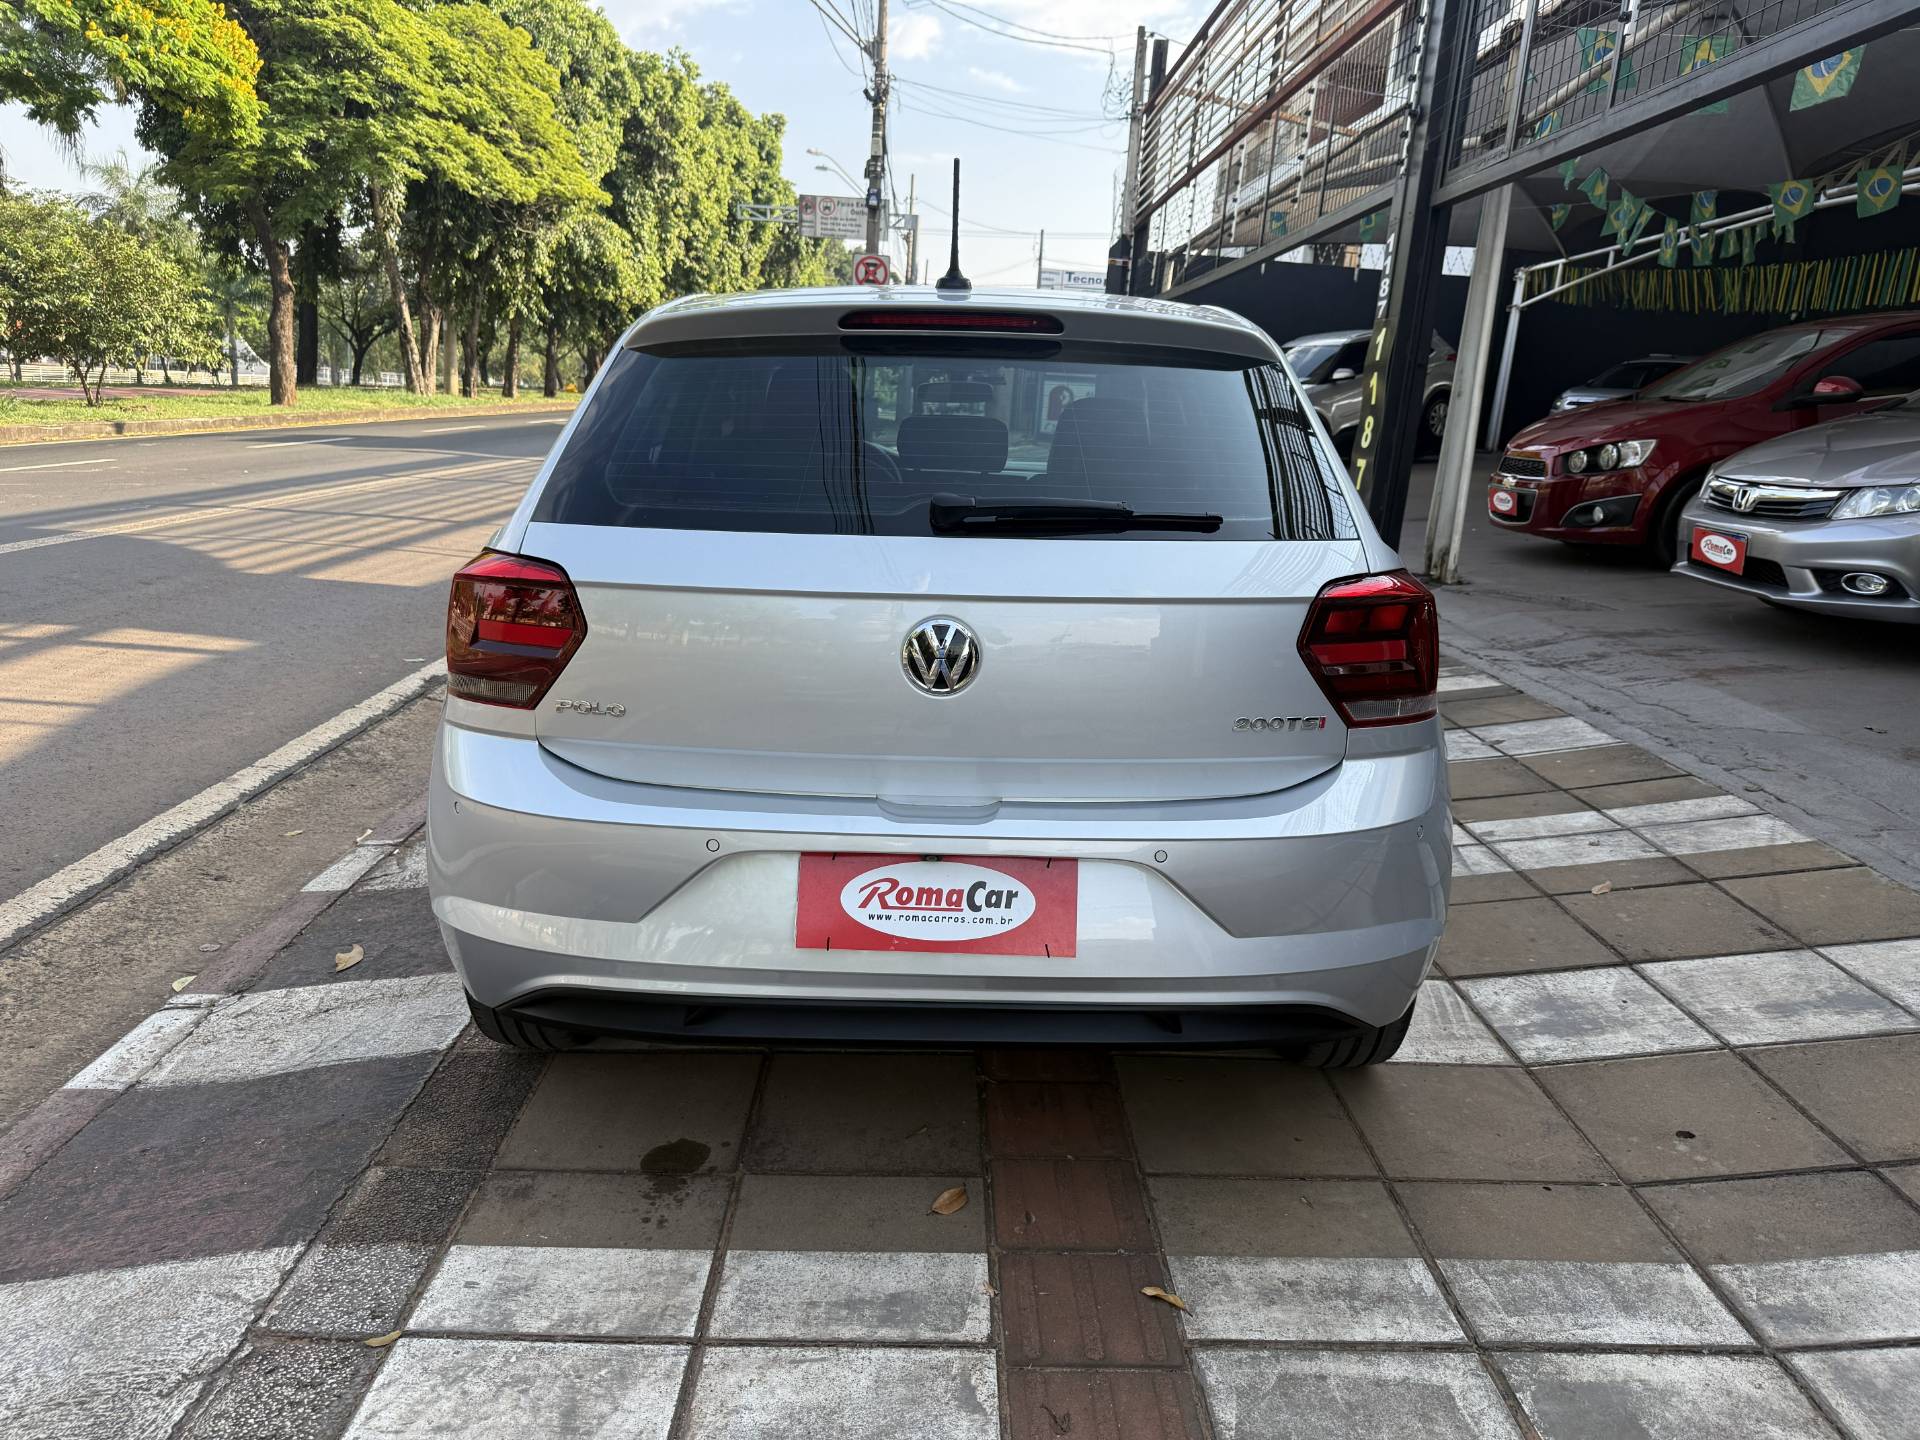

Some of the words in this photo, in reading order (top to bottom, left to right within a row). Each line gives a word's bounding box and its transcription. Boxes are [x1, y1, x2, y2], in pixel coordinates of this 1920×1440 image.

[1357, 327, 1387, 491] 1187
[555, 699, 626, 718] POLO
[858, 877, 1019, 913] RomaCar
[868, 912, 1013, 925] www.romacarros.com.br
